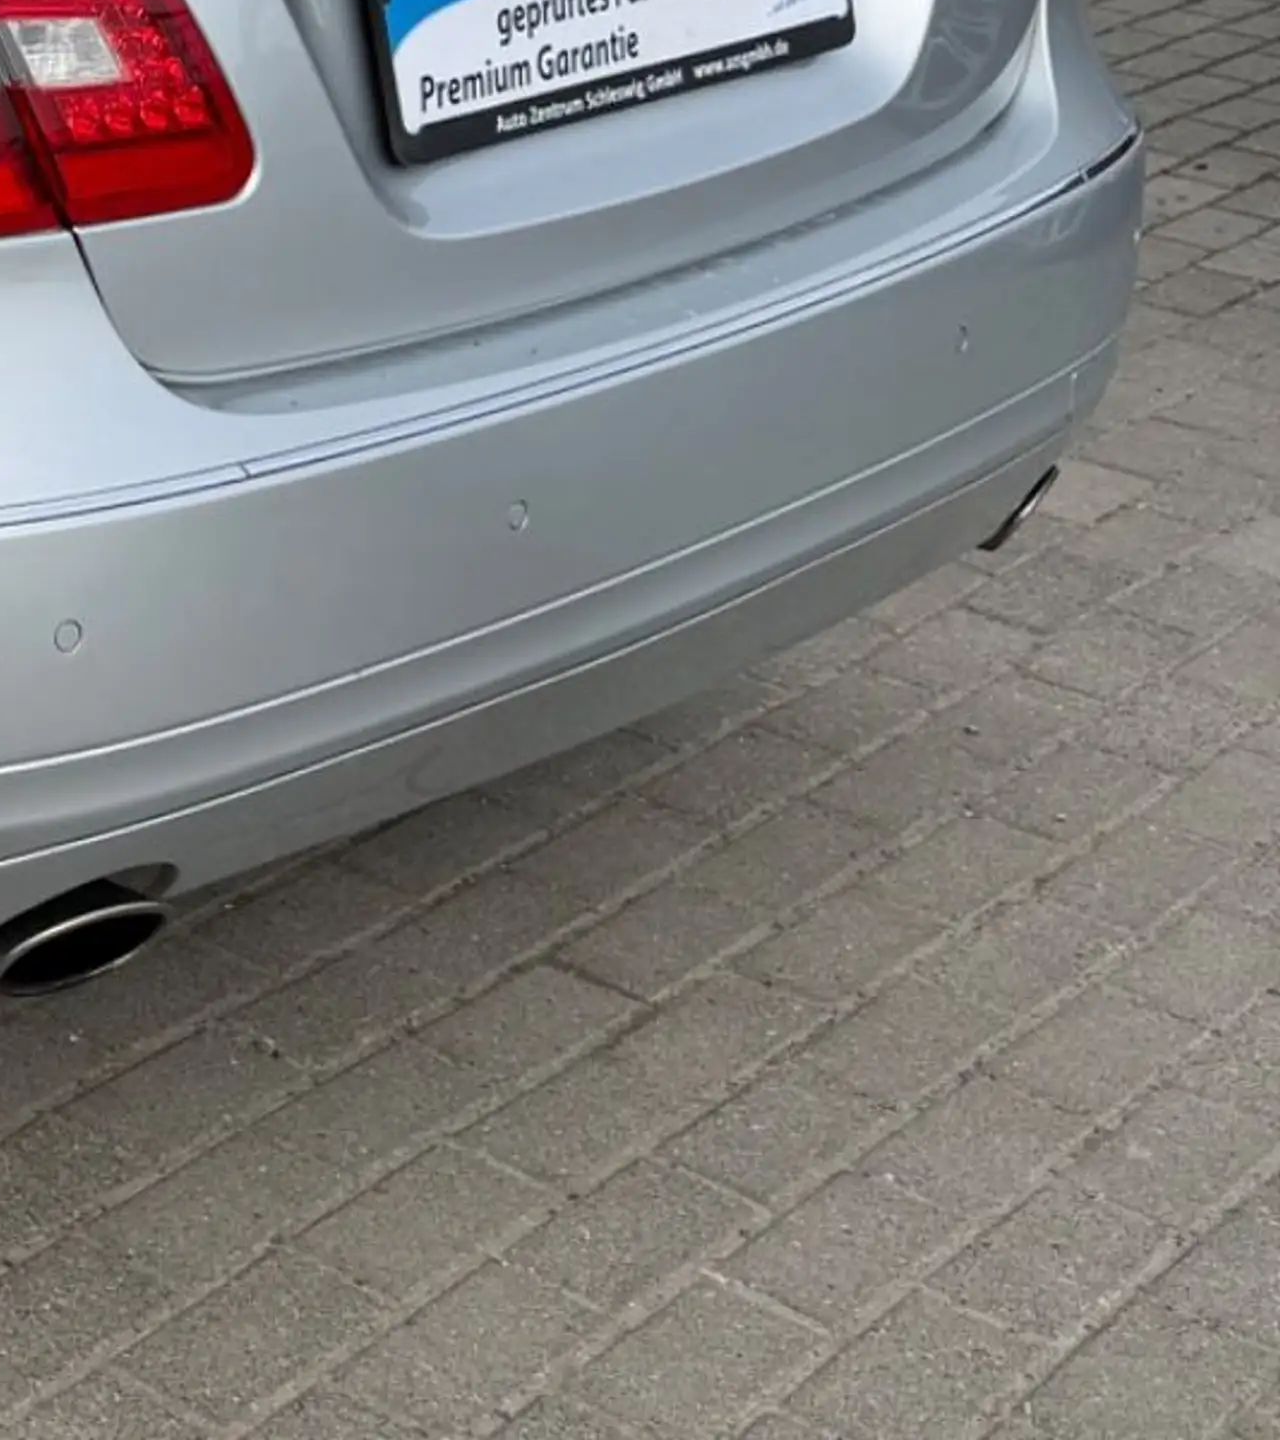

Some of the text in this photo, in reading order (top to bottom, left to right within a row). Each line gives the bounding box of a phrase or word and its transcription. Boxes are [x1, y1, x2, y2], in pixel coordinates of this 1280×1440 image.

[420, 25, 640, 114] Premium Garantie
[496, 113, 528, 133] Auto
[528, 95, 585, 125] Zentrum
